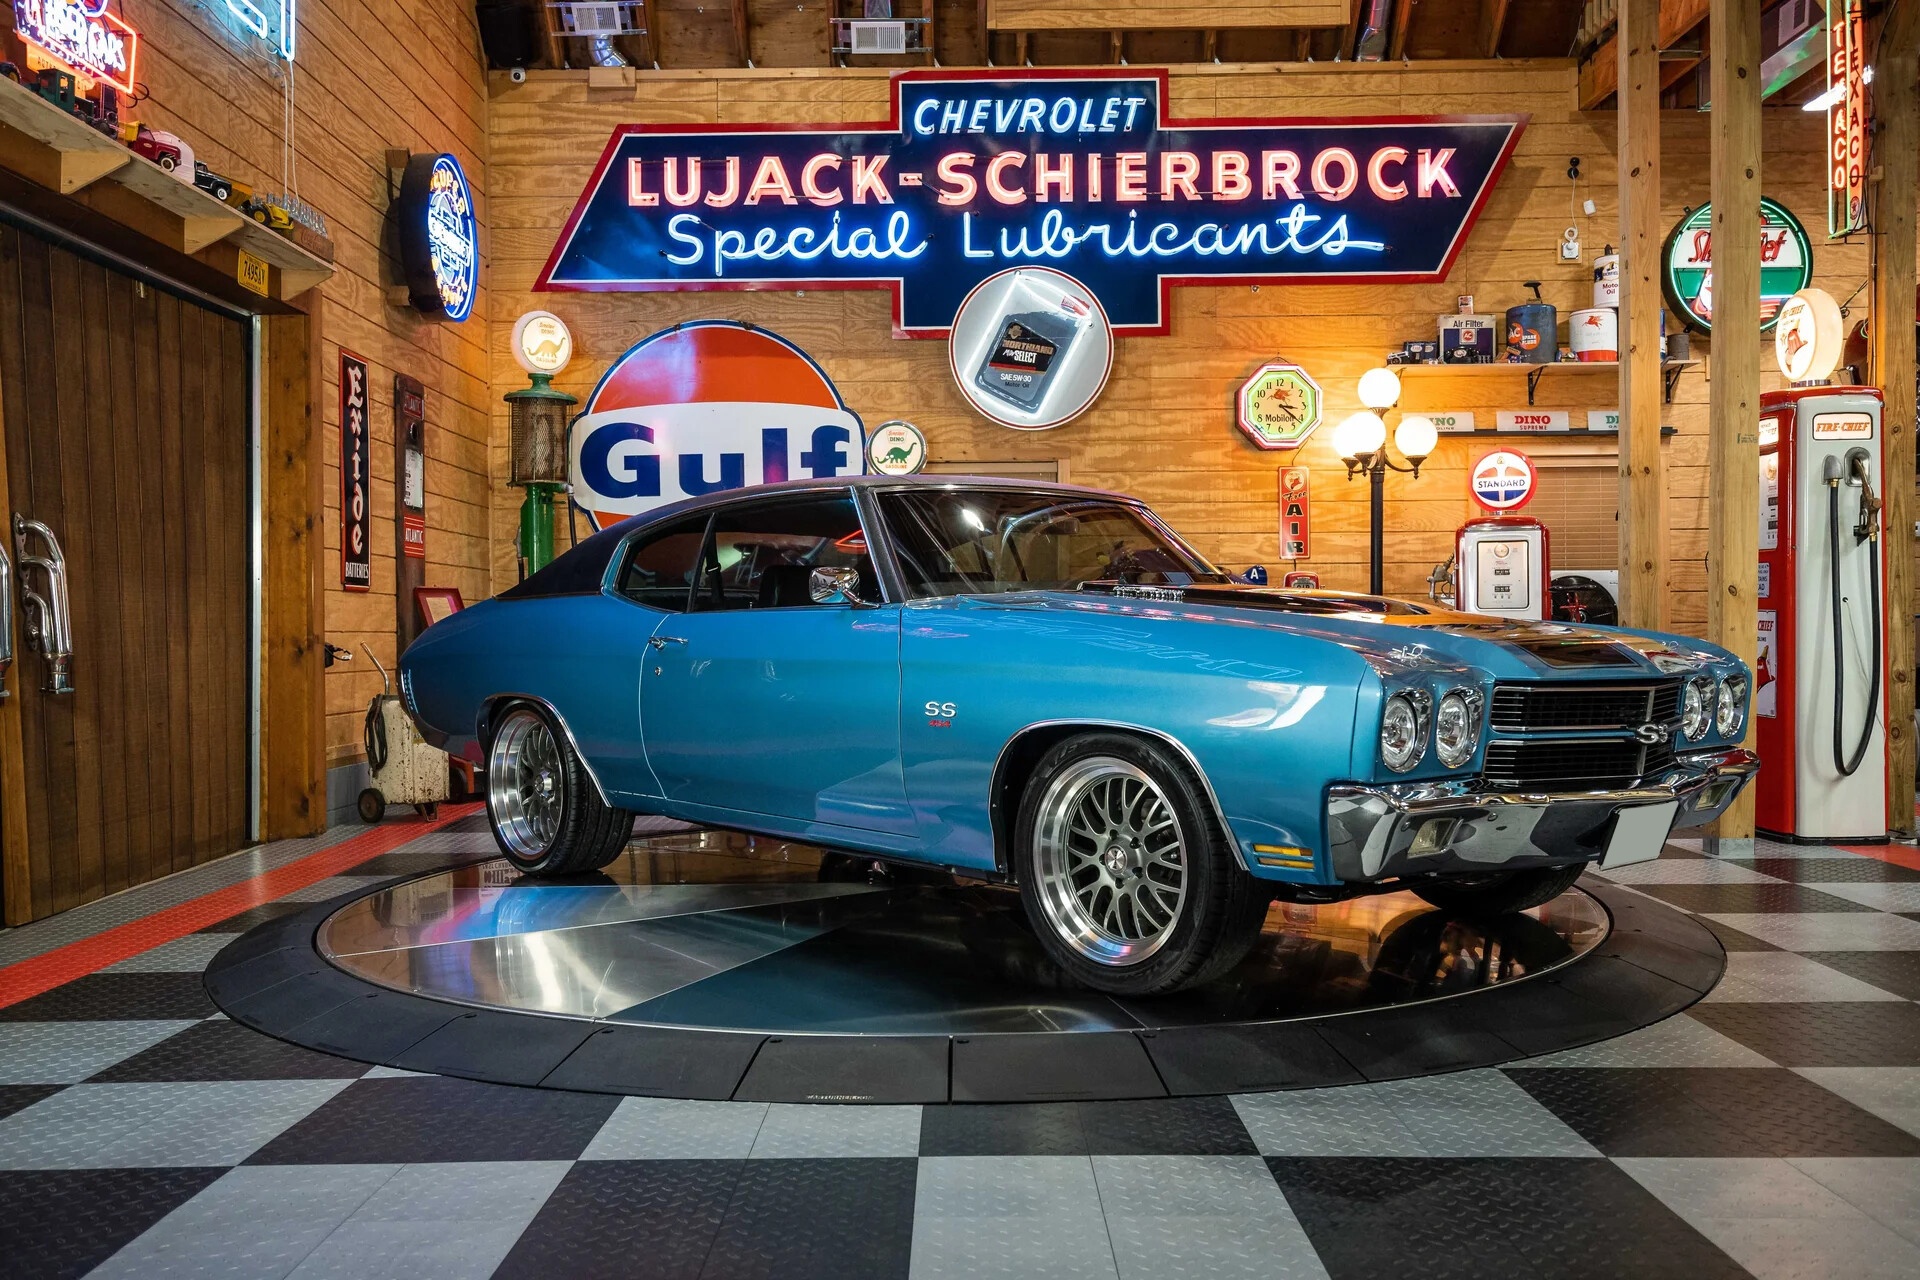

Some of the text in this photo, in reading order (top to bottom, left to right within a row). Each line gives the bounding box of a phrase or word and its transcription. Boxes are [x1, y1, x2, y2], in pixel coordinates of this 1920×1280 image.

[914, 97, 1147, 135] CHEVROLET
[627, 146, 1462, 207] LUJACK-SCHIERBROCK
[963, 203, 1386, 258] Lubricants
[666, 211, 930, 276] Special
[1453, 320, 1484, 328] Air Filter
[1508, 327, 1521, 340] AC
[1014, 350, 1038, 364] SELECT
[1000, 373, 1014, 381] SAE
[1257, 390, 1266, 398] 10
[1299, 389, 1303, 397] 2
[1301, 402, 1306, 410] 3
[1257, 414, 1262, 422] 8
[1514, 415, 1551, 425] DINO
[1278, 425, 1283, 433] 6
[1291, 422, 1296, 430] 5
[580, 421, 850, 498] Gulf
[1478, 479, 1526, 489] STANDARD
[405, 529, 424, 545] ATLANTIC
[345, 561, 370, 580] BATTERIES
[1250, 568, 1259, 580] A
[924, 701, 957, 718] SS
